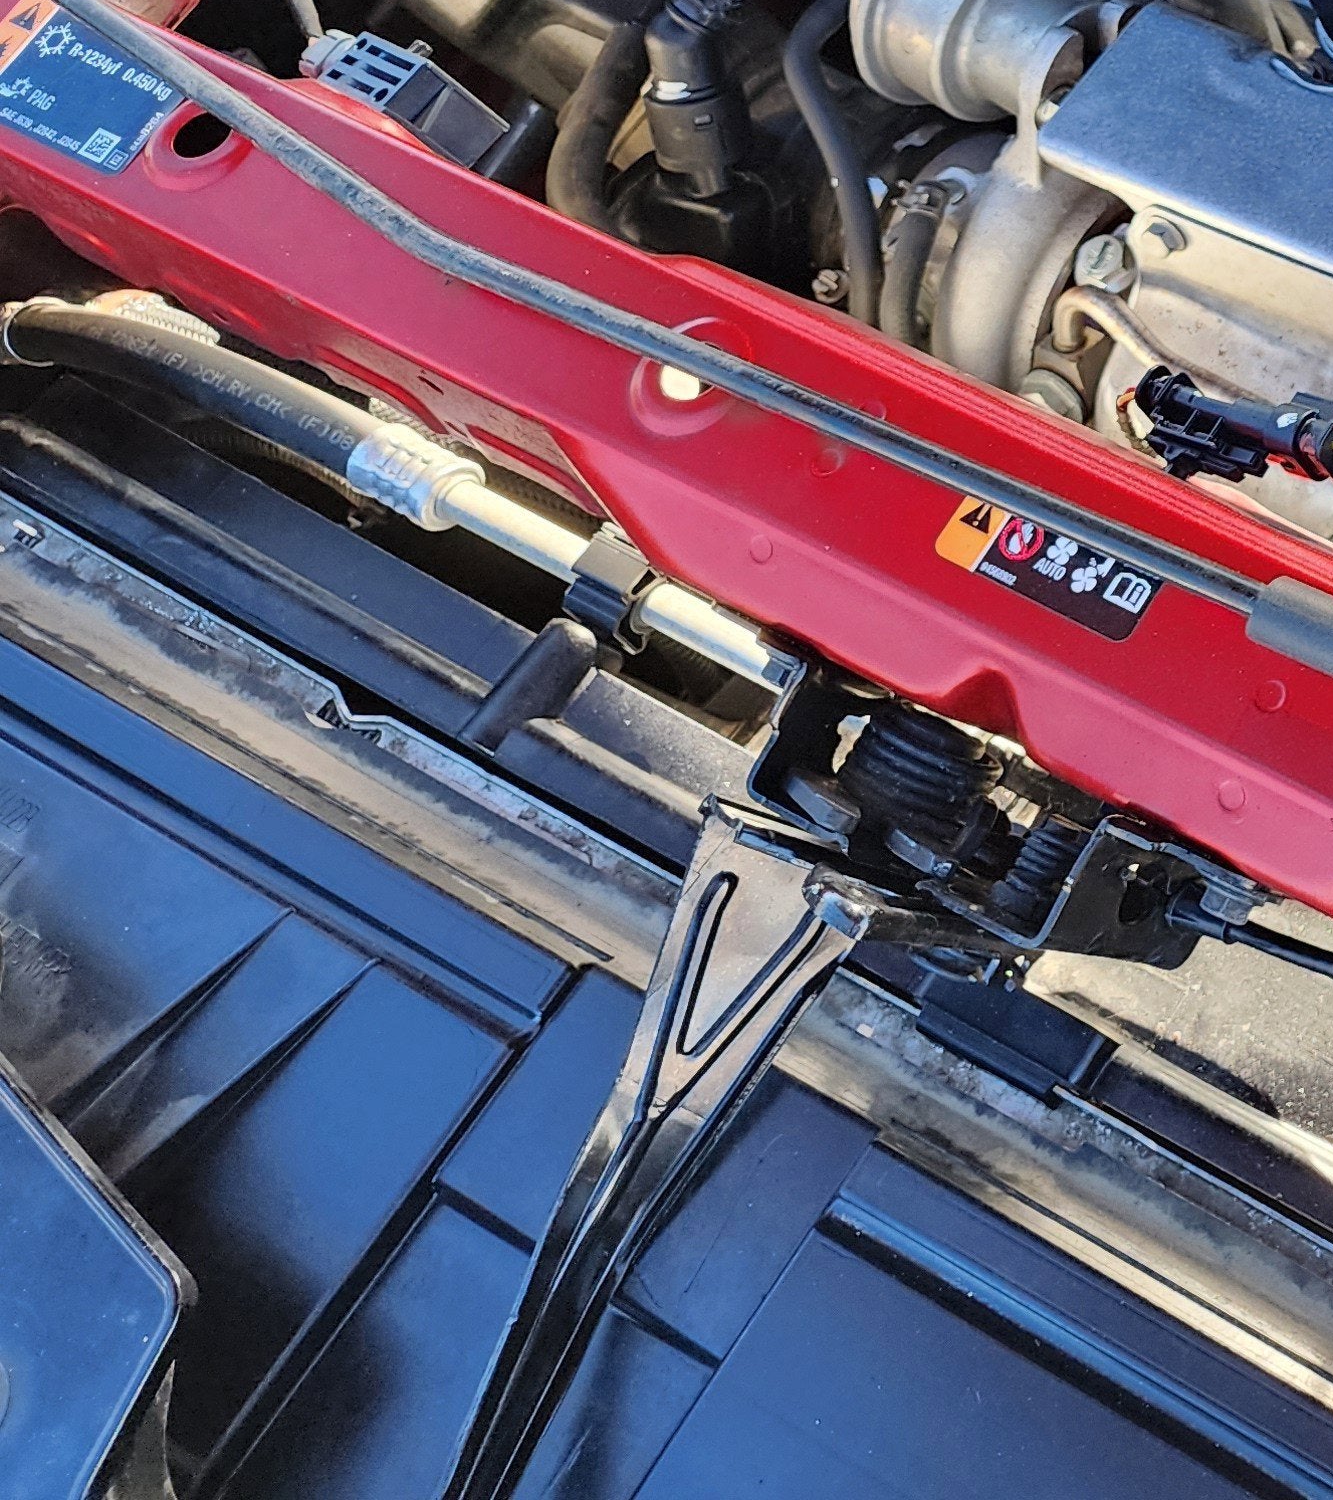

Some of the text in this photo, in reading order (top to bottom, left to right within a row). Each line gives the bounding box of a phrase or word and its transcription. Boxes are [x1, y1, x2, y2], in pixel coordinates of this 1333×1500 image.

[67, 42, 174, 103] R-1234yf 0.450 kg
[26, 87, 57, 112] PAG
[0, 107, 17, 122] SAE
[56, 132, 82, 151] J2845
[1032, 557, 1067, 582] AUTO
